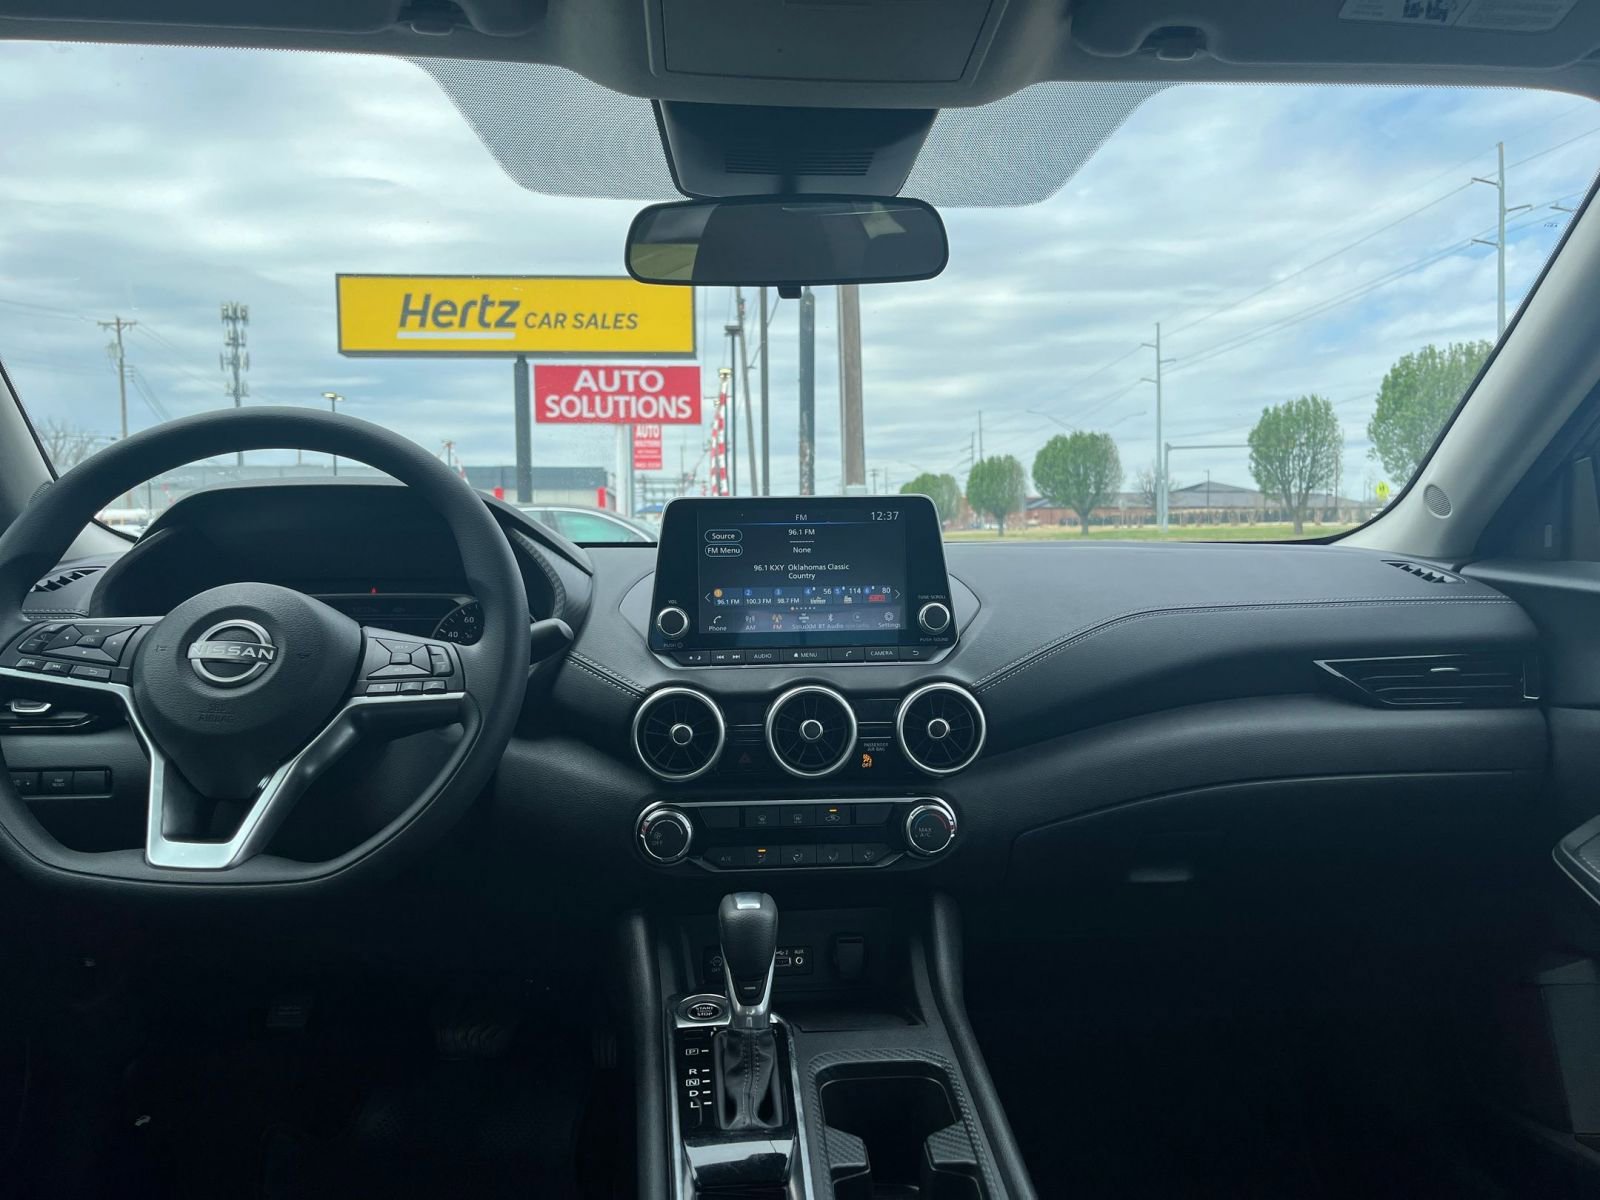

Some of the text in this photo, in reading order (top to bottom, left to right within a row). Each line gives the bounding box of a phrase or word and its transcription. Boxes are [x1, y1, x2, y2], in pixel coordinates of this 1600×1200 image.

[398, 293, 639, 330] Hertz CAR SALES
[573, 369, 665, 393] AUTO
[545, 394, 693, 420] SOLUTIONS
[636, 424, 660, 438] AUTO
[795, 513, 808, 521] FM
[871, 511, 900, 521] 12:37
[711, 532, 736, 540] Source
[792, 546, 812, 554] None
[753, 562, 850, 572] 96.1 KXY Oklahomas Classic
[788, 572, 816, 581] Country
[463, 616, 475, 624] 60
[191, 643, 275, 661] NISSAN
[753, 652, 772, 660] AUDIO
[800, 651, 818, 659] MENU
[688, 1089, 699, 1097] D
